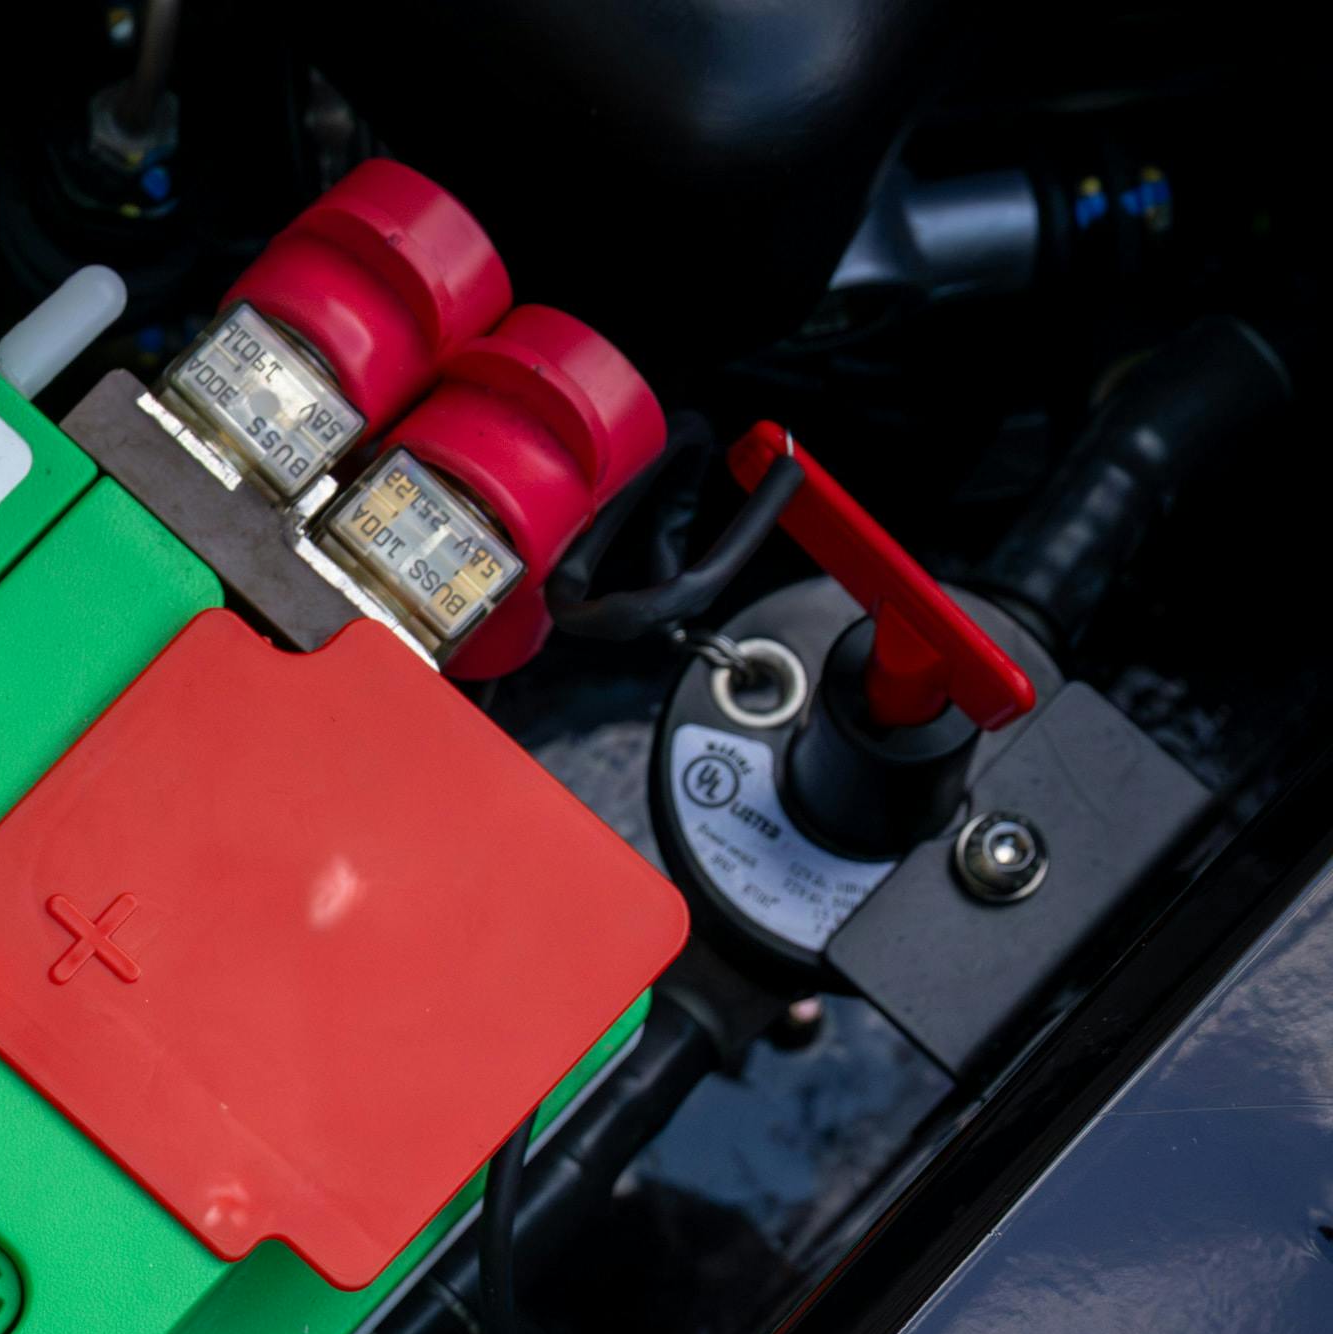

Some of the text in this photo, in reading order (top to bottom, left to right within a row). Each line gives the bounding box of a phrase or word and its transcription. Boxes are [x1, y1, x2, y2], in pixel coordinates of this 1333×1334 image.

[184, 352, 311, 479] BUSS 300A
[347, 502, 468, 617] BUSS 100A
